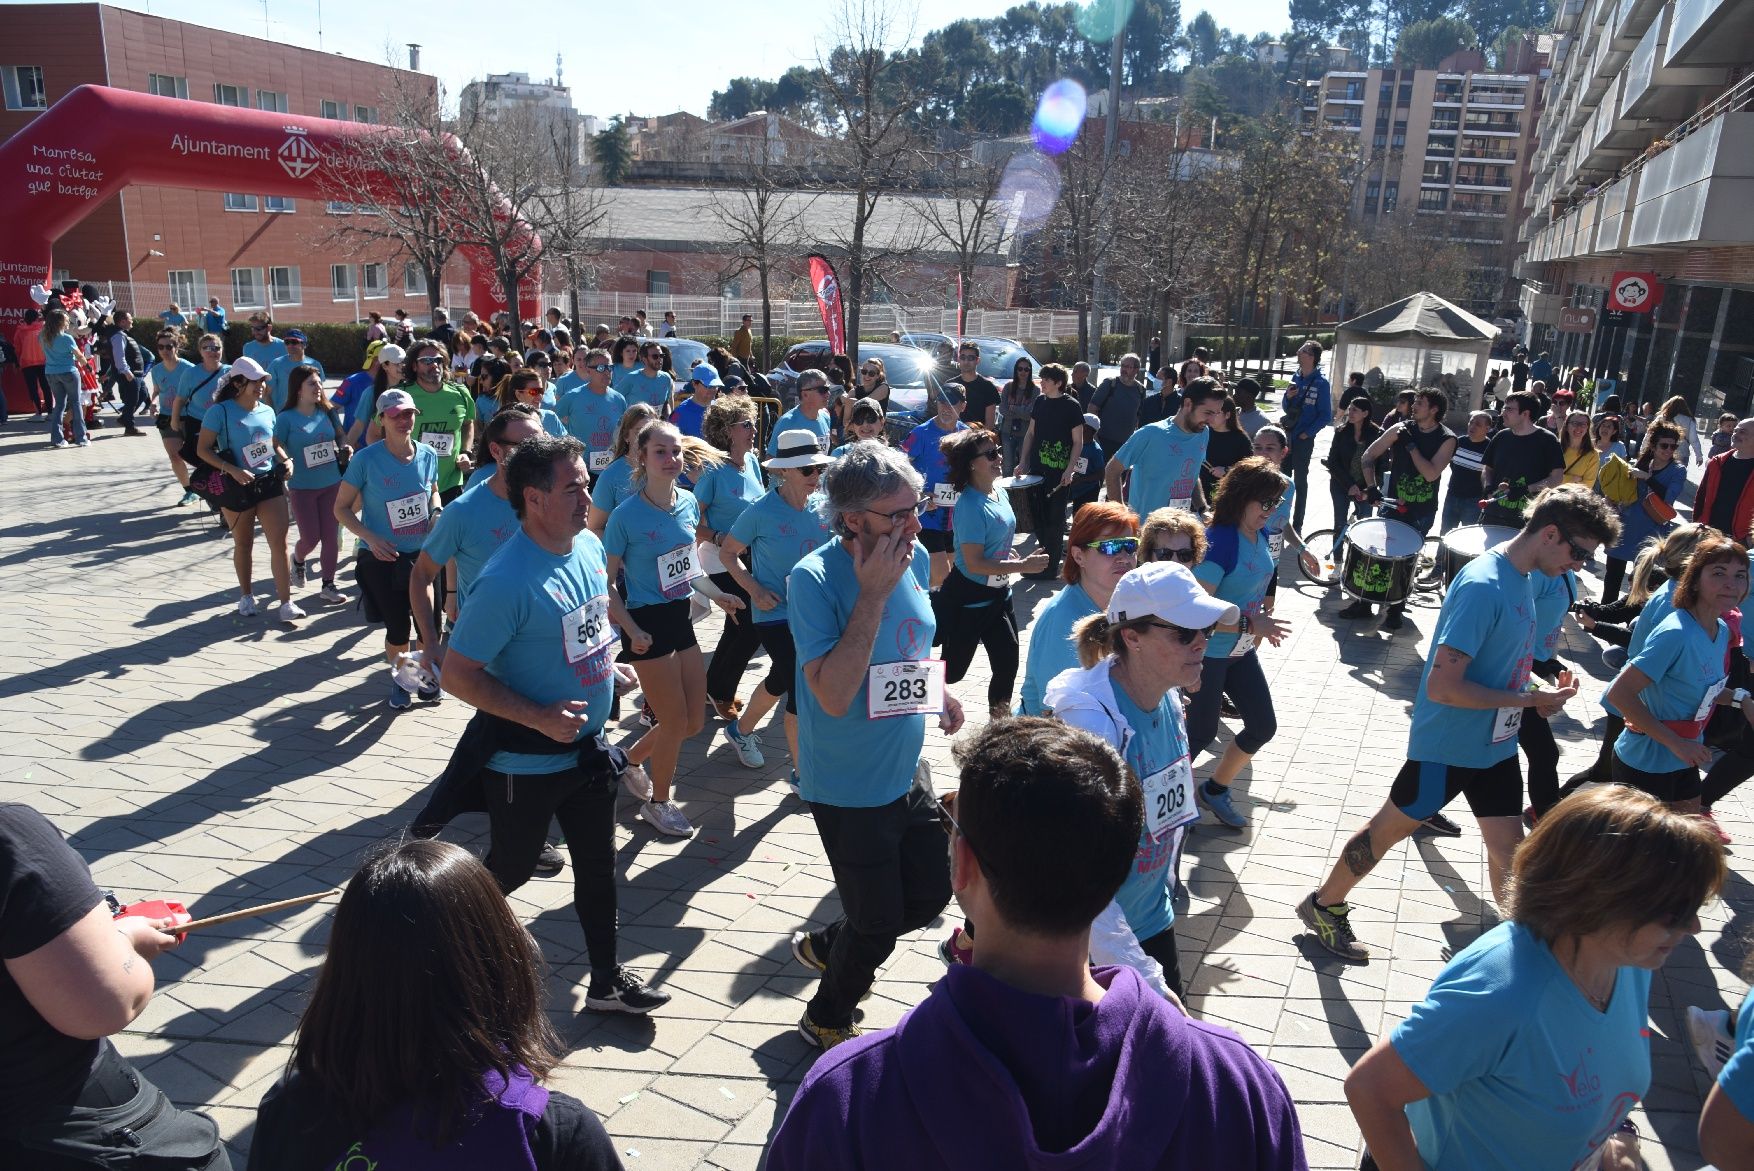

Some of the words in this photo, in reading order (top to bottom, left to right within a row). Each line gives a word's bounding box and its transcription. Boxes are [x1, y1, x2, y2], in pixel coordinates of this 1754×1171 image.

[33, 145, 96, 164] Manresa,
[171, 134, 271, 161] Ajuntament
[26, 163, 53, 175] una
[59, 164, 103, 181] ciutat
[28, 181, 51, 196] que
[58, 182, 98, 199] batega
[0, 262, 48, 274] juntament
[250, 445, 268, 459] 598
[311, 448, 329, 460] 703
[428, 440, 447, 451] 342
[398, 503, 421, 519] 345
[667, 556, 691, 578] 208
[884, 678, 927, 702] 283
[1156, 783, 1185, 820] 203
